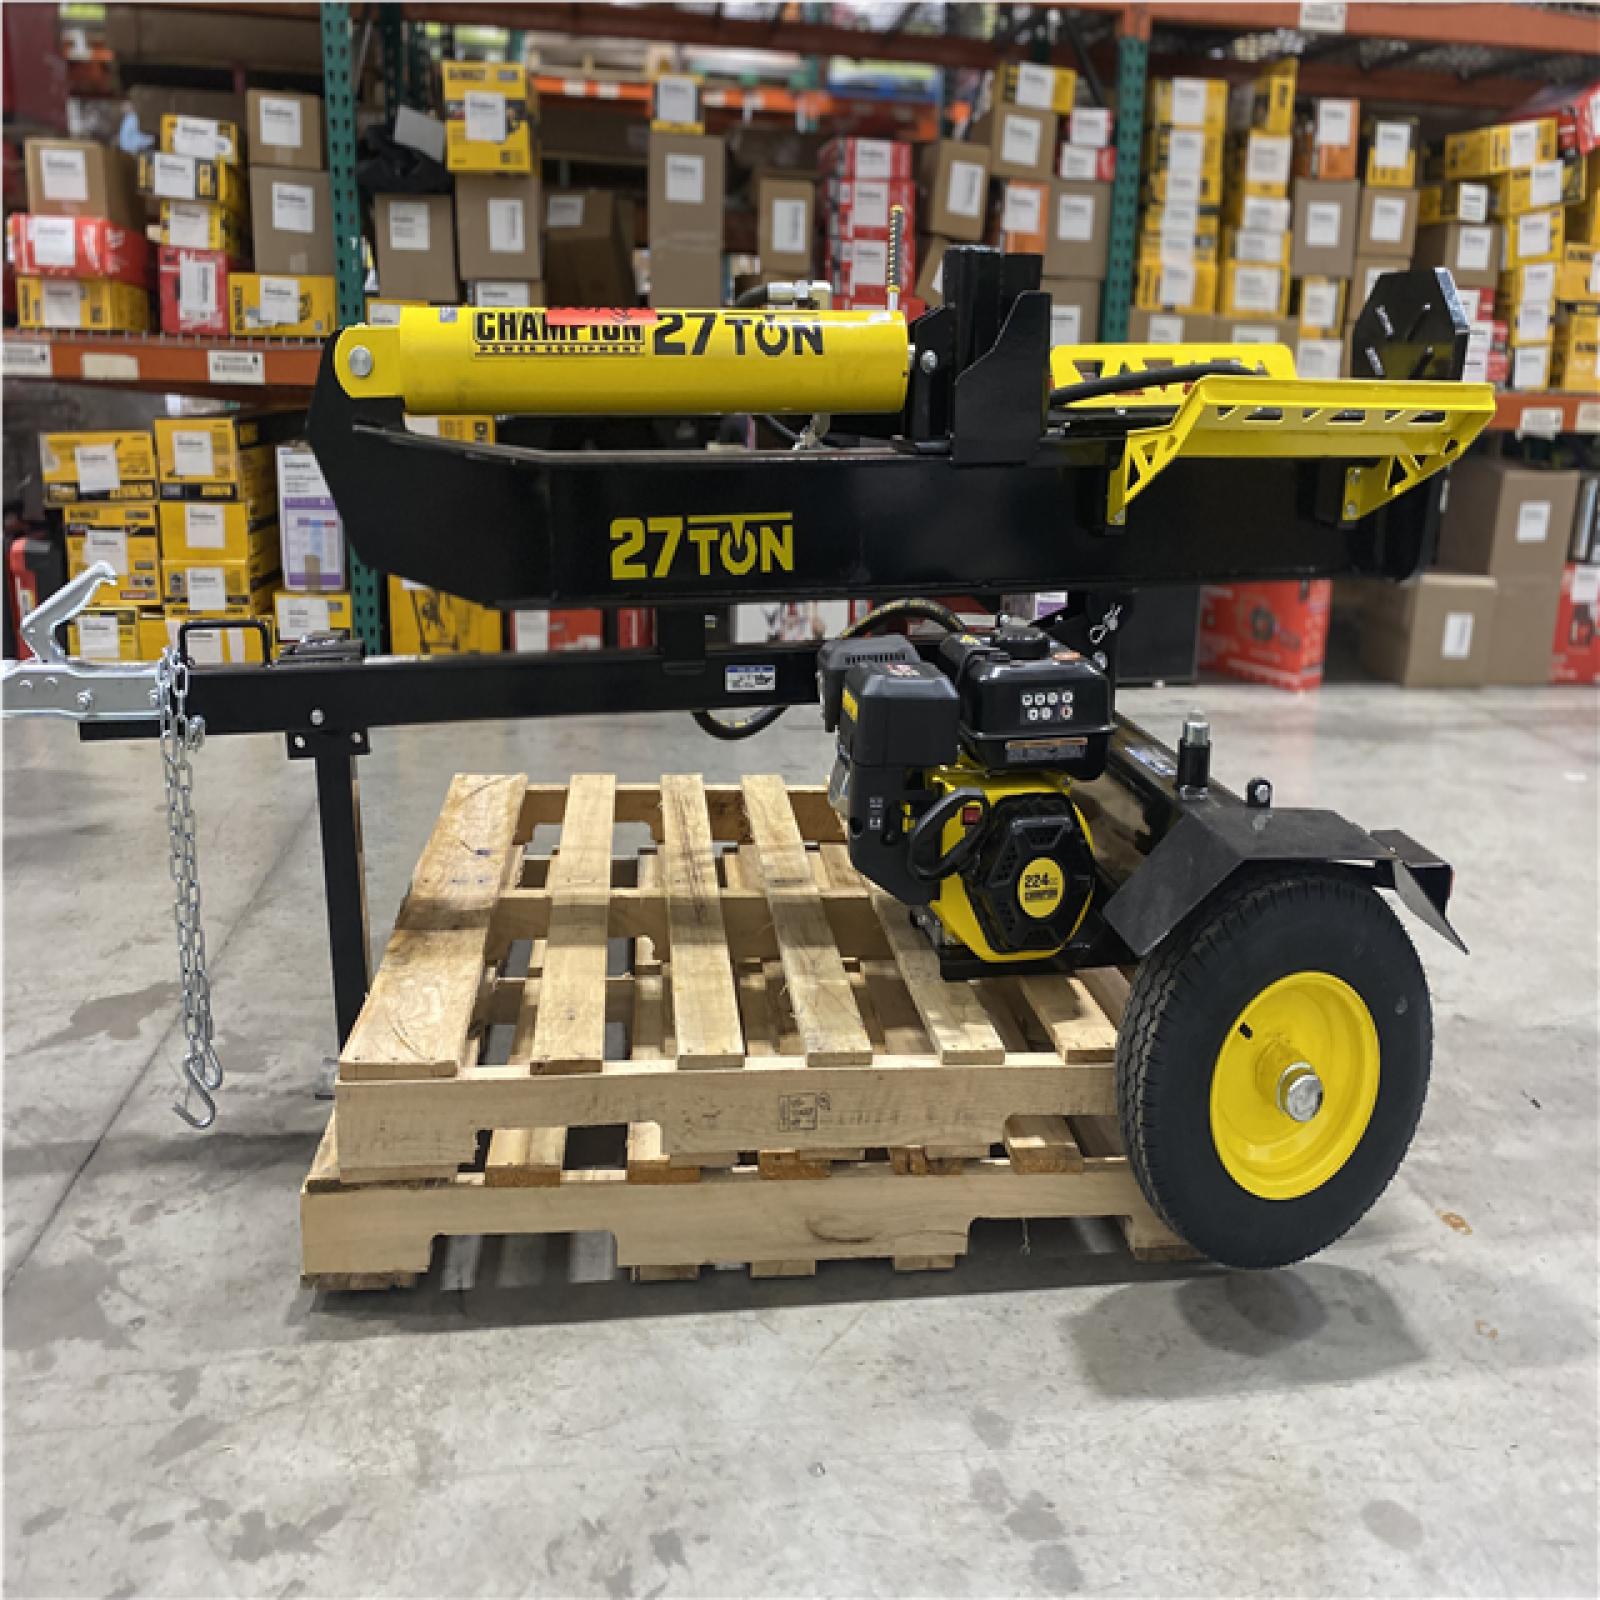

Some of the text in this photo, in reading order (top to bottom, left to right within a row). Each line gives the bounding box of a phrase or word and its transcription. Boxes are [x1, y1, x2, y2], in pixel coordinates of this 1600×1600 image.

[654, 311, 717, 356] 27
[723, 312, 825, 356] TON
[609, 514, 794, 581] 27 TON
